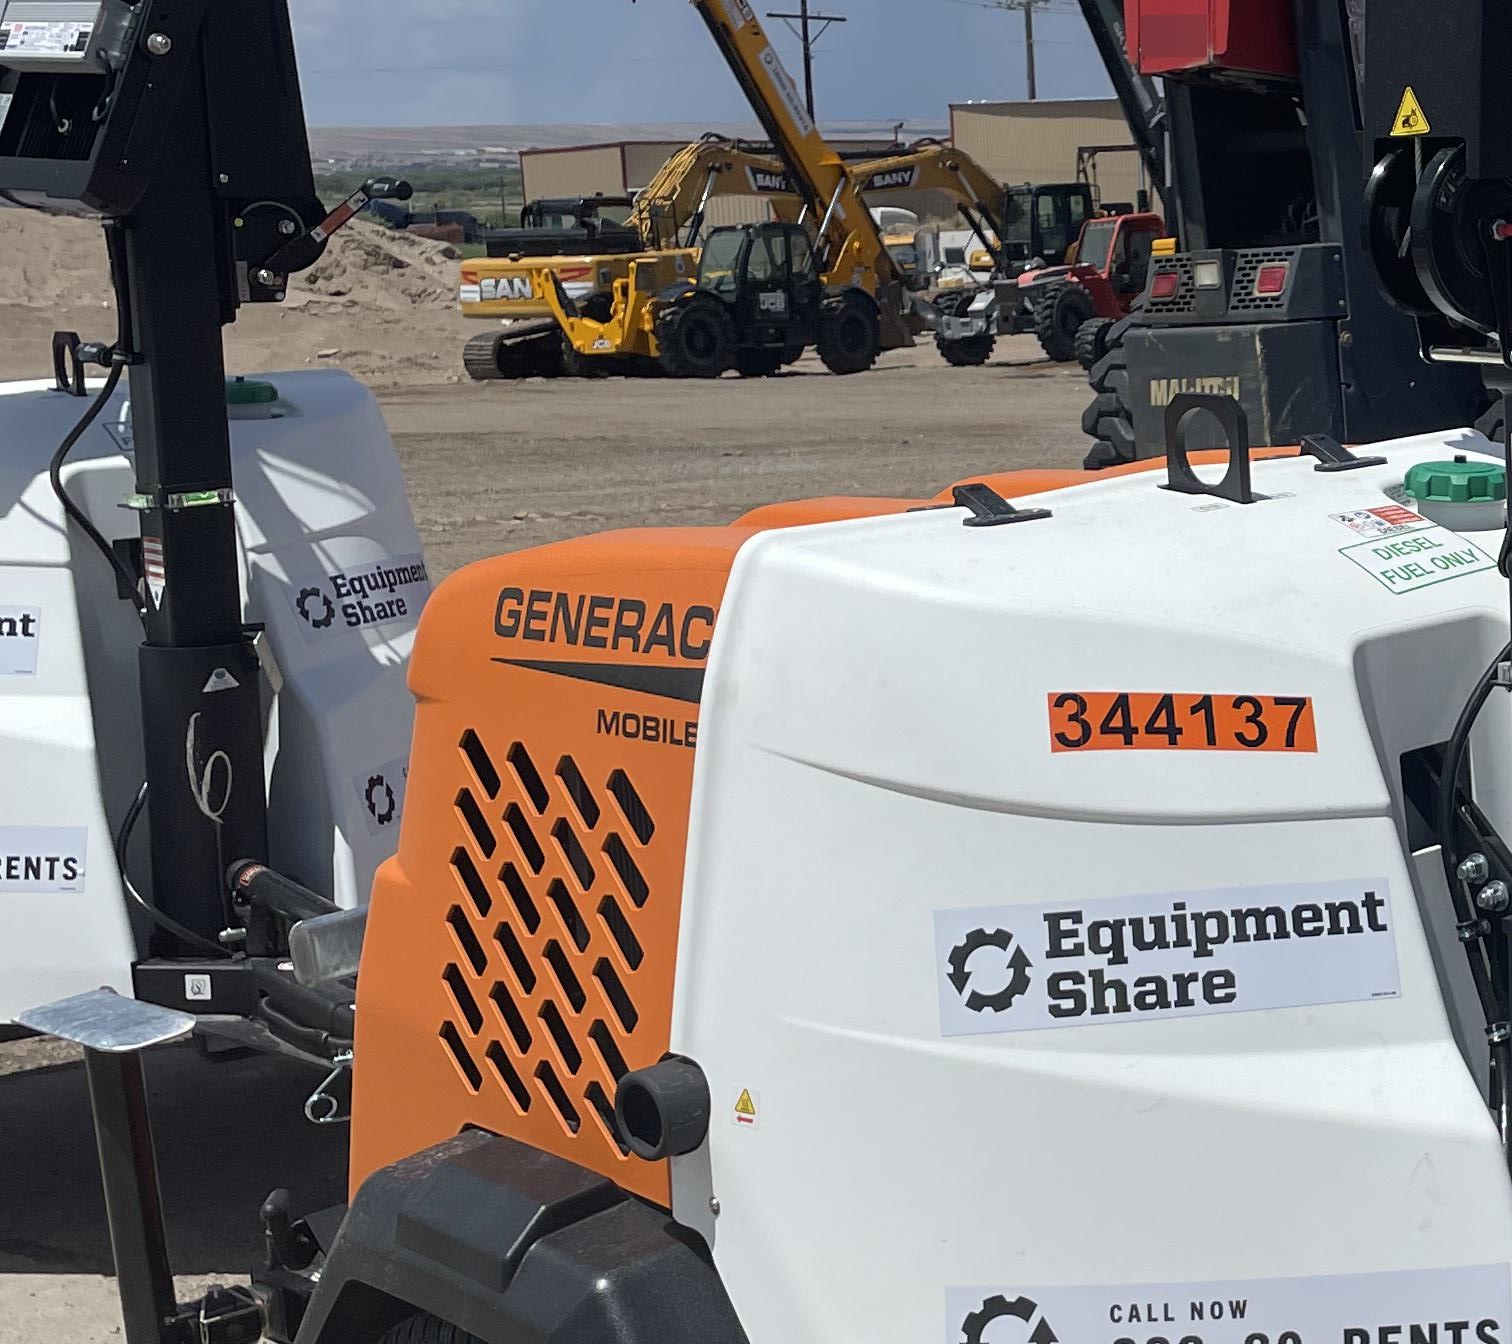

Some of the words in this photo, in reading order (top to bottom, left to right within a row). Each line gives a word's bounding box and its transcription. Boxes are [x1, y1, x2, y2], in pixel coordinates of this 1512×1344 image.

[873, 171, 912, 187] SANY
[480, 277, 533, 300] SAN
[1372, 536, 1444, 561] DIESEL
[1379, 560, 1436, 585] FUEL
[1431, 548, 1480, 570] ONLY
[341, 597, 408, 628] Share
[494, 587, 714, 660] GENERAC
[596, 709, 698, 748] MOBILE
[1053, 692, 1307, 748] 344137
[1043, 891, 1388, 966] Equipment
[1046, 968, 1237, 1018] Share
[1109, 1302, 1176, 1324] CALL
[1190, 1299, 1249, 1321] NOW
